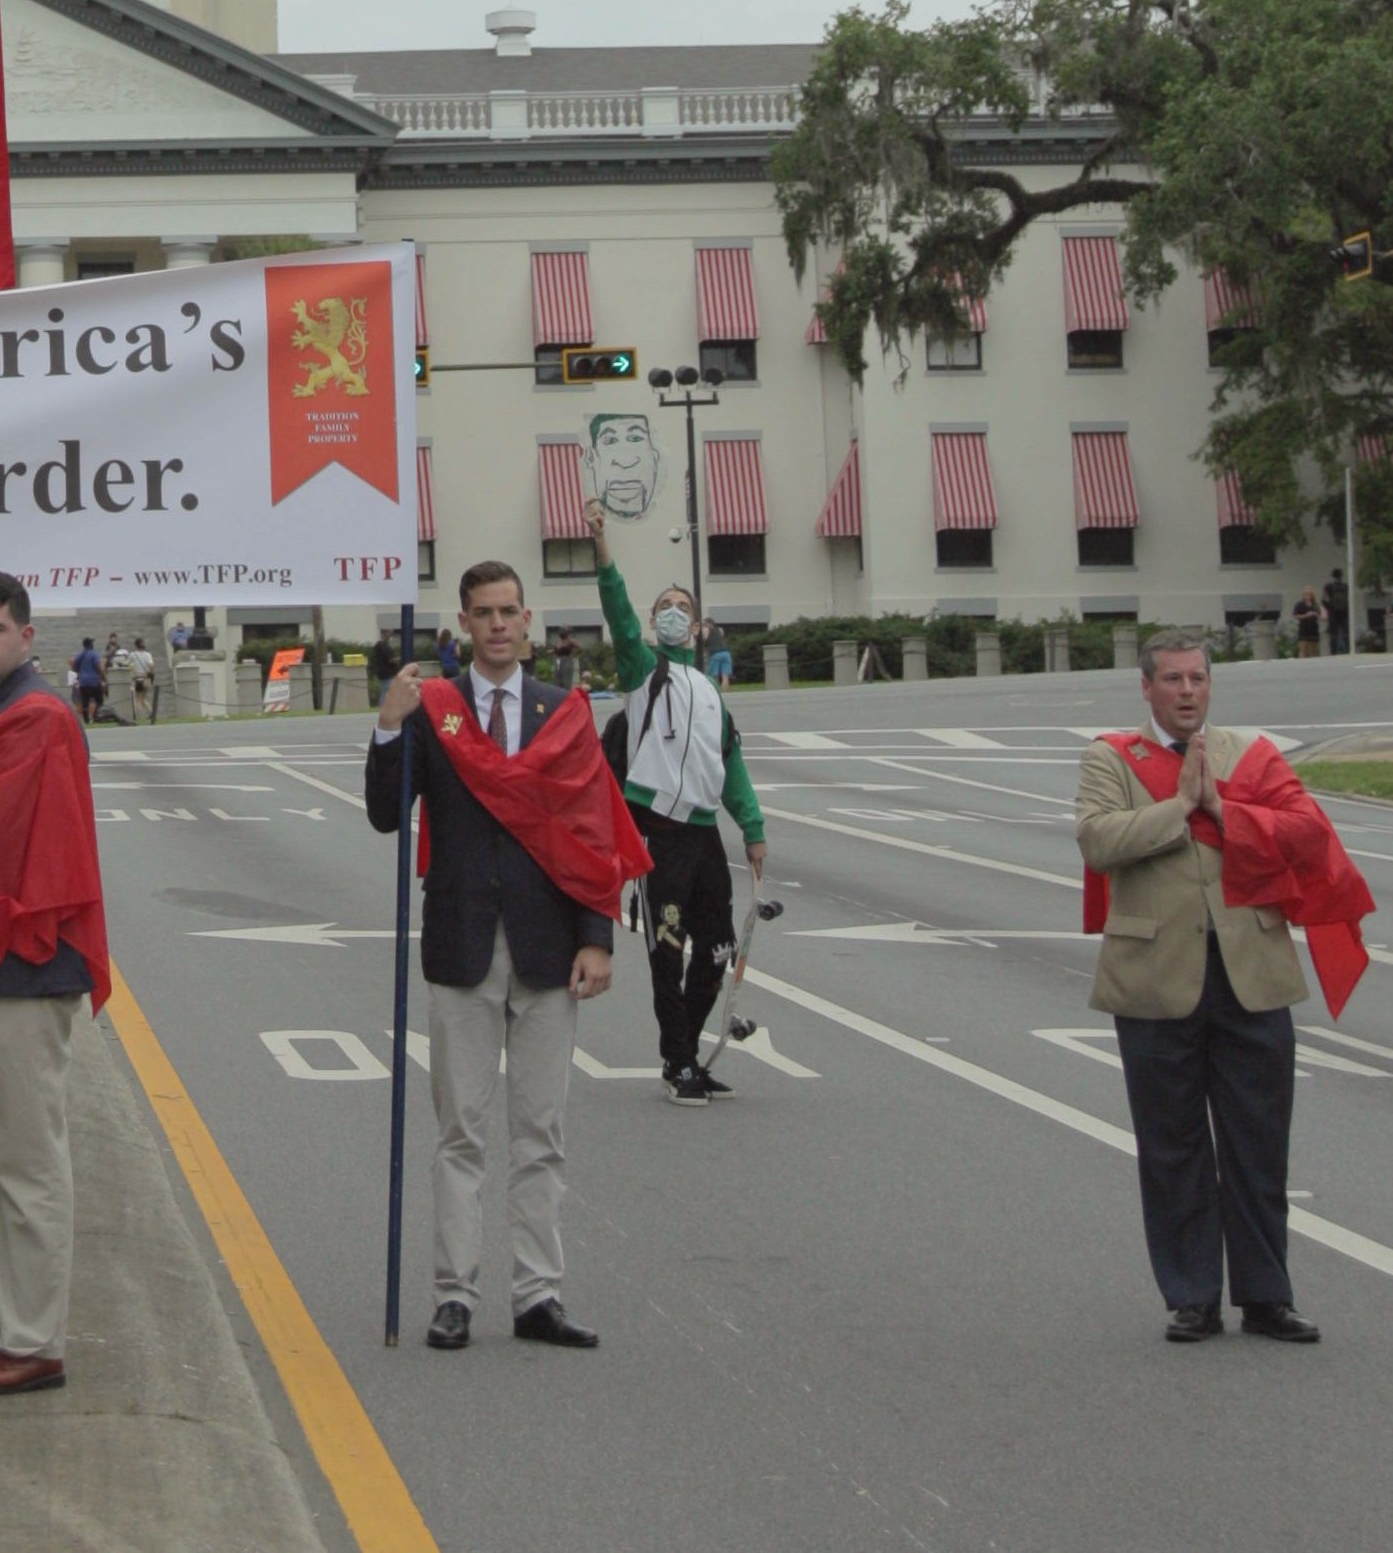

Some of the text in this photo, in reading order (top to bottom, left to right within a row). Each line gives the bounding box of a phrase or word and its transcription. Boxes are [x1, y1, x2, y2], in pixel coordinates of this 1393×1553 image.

[306, 412, 359, 421] TRADITION
[315, 423, 350, 432] FAMILY
[308, 434, 358, 444] PROPERTY
[333, 556, 402, 582] TFP
[50, 567, 100, 588] TFP
[134, 564, 293, 588] www.TFP.org
